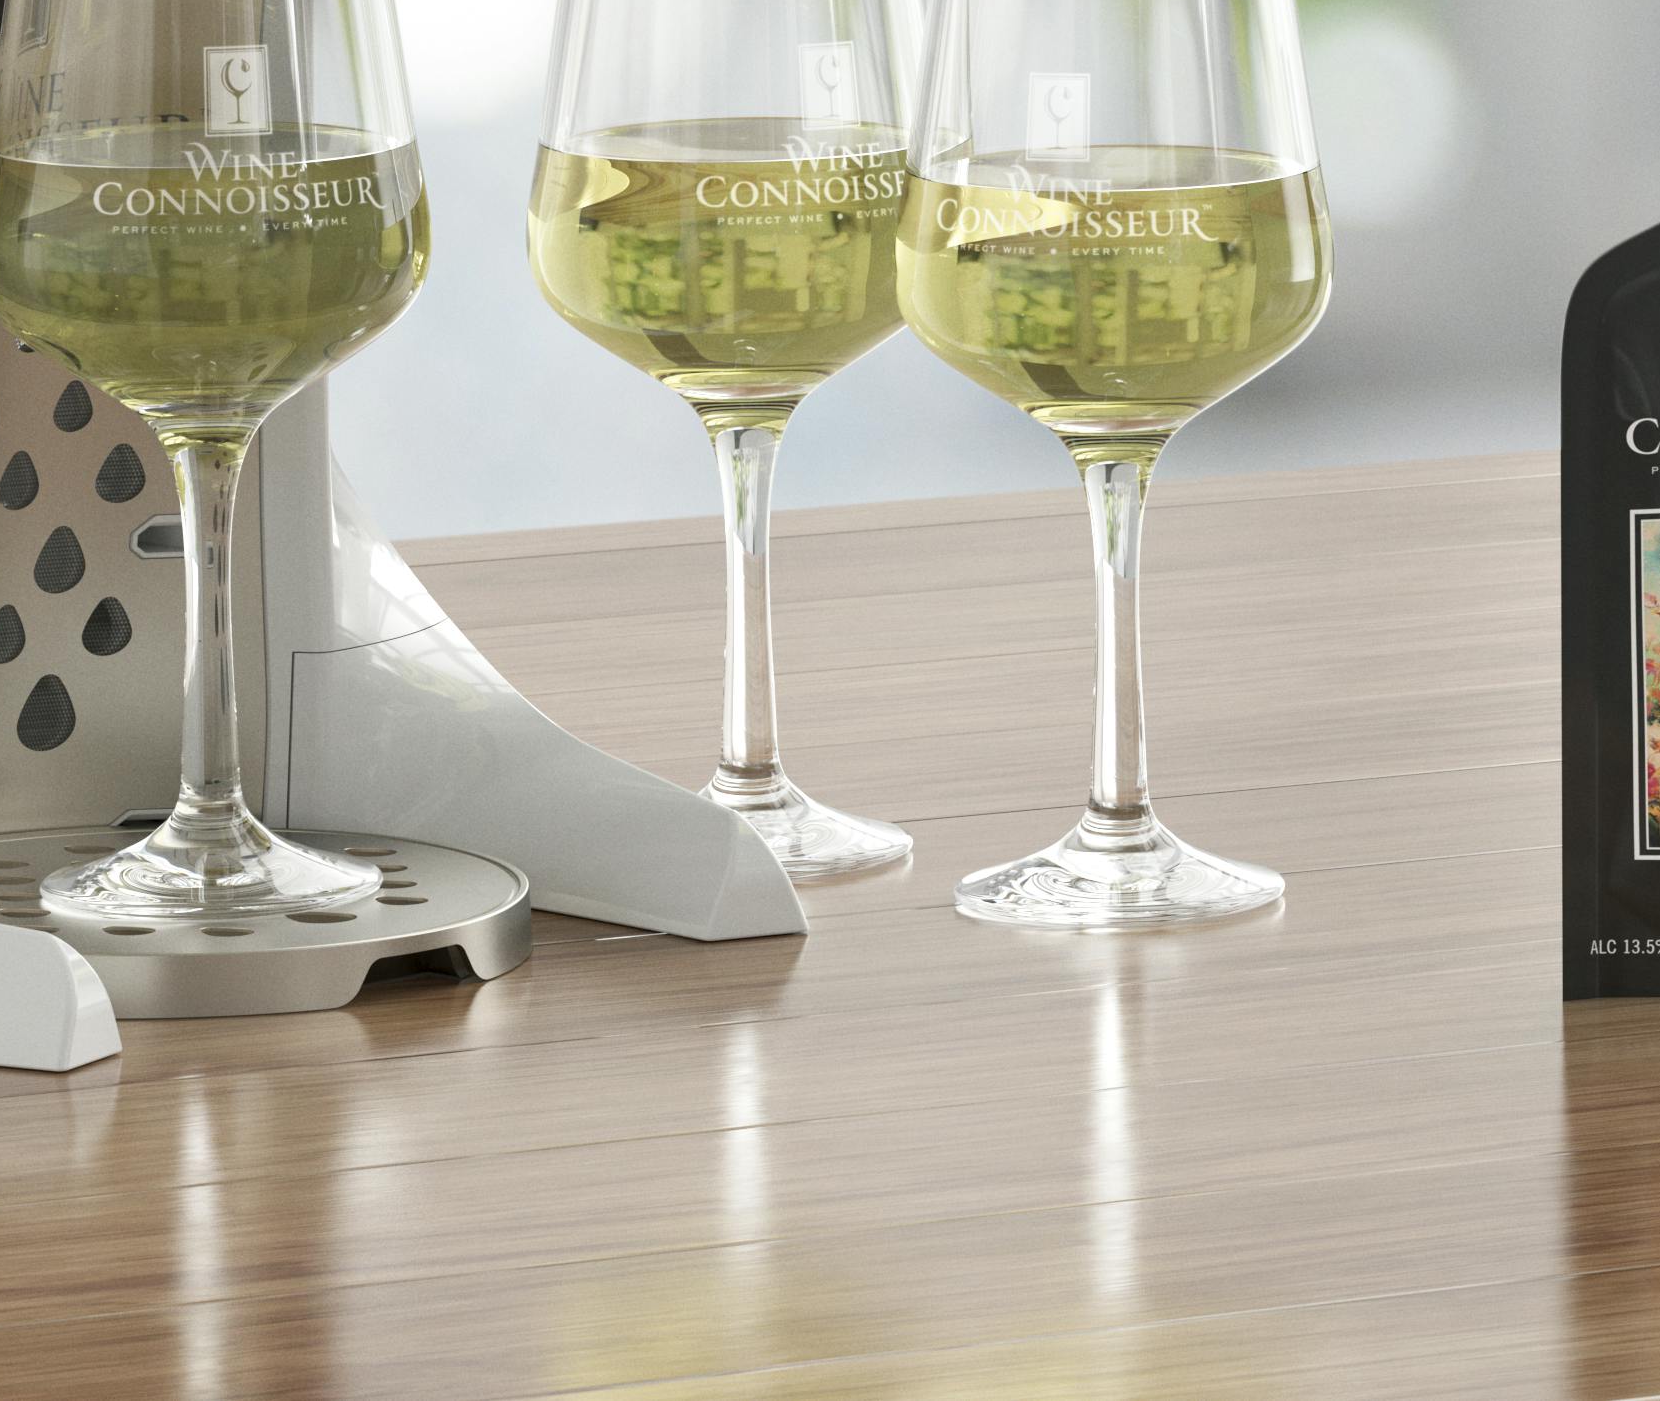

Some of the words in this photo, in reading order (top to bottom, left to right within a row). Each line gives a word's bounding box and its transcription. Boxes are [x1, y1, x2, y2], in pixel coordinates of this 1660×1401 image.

[184, 142, 298, 183] WINE
[783, 135, 883, 175] WINE
[696, 169, 906, 209] CONNOISSE
[1003, 164, 1114, 205] WINE
[112, 226, 178, 235] PERFECT
[187, 225, 223, 234] WINE
[717, 216, 782, 226] PERFECT
[789, 213, 824, 224] WINE
[1003, 246, 1036, 255] WINE
[1072, 247, 1120, 256] EVERY
[1130, 246, 1166, 255] TIME
[1590, 939, 1617, 955] ALC
